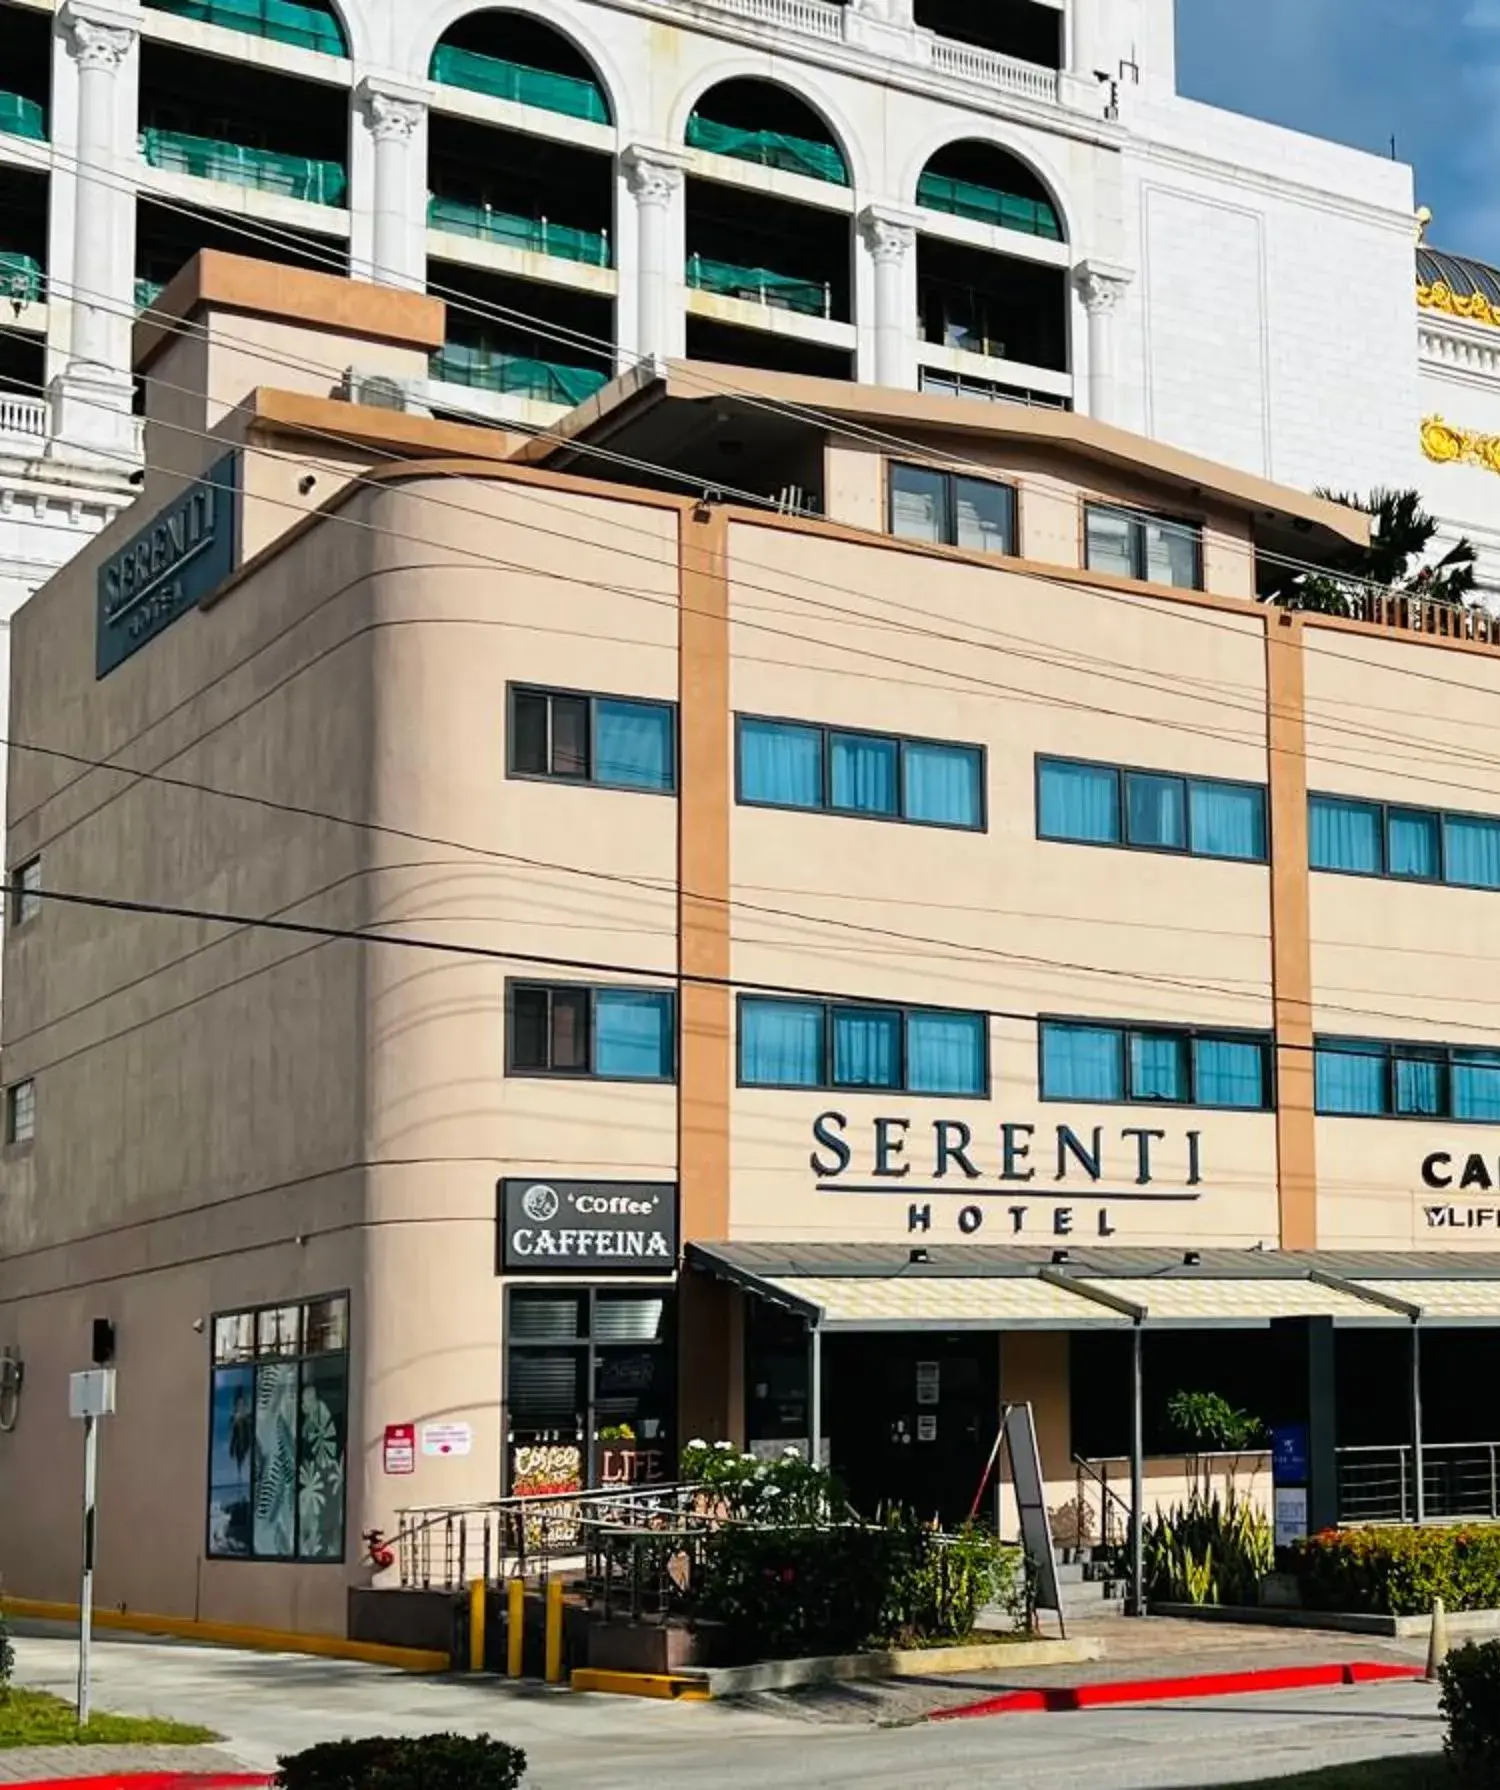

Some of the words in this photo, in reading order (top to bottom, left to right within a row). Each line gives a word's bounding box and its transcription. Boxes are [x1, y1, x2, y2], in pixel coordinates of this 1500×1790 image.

[105, 488, 214, 614] SERENTI
[809, 1111, 1201, 1185] SERENTI
[512, 1228, 670, 1257] CAFFEINA
[908, 1203, 1116, 1236] HOTEL
